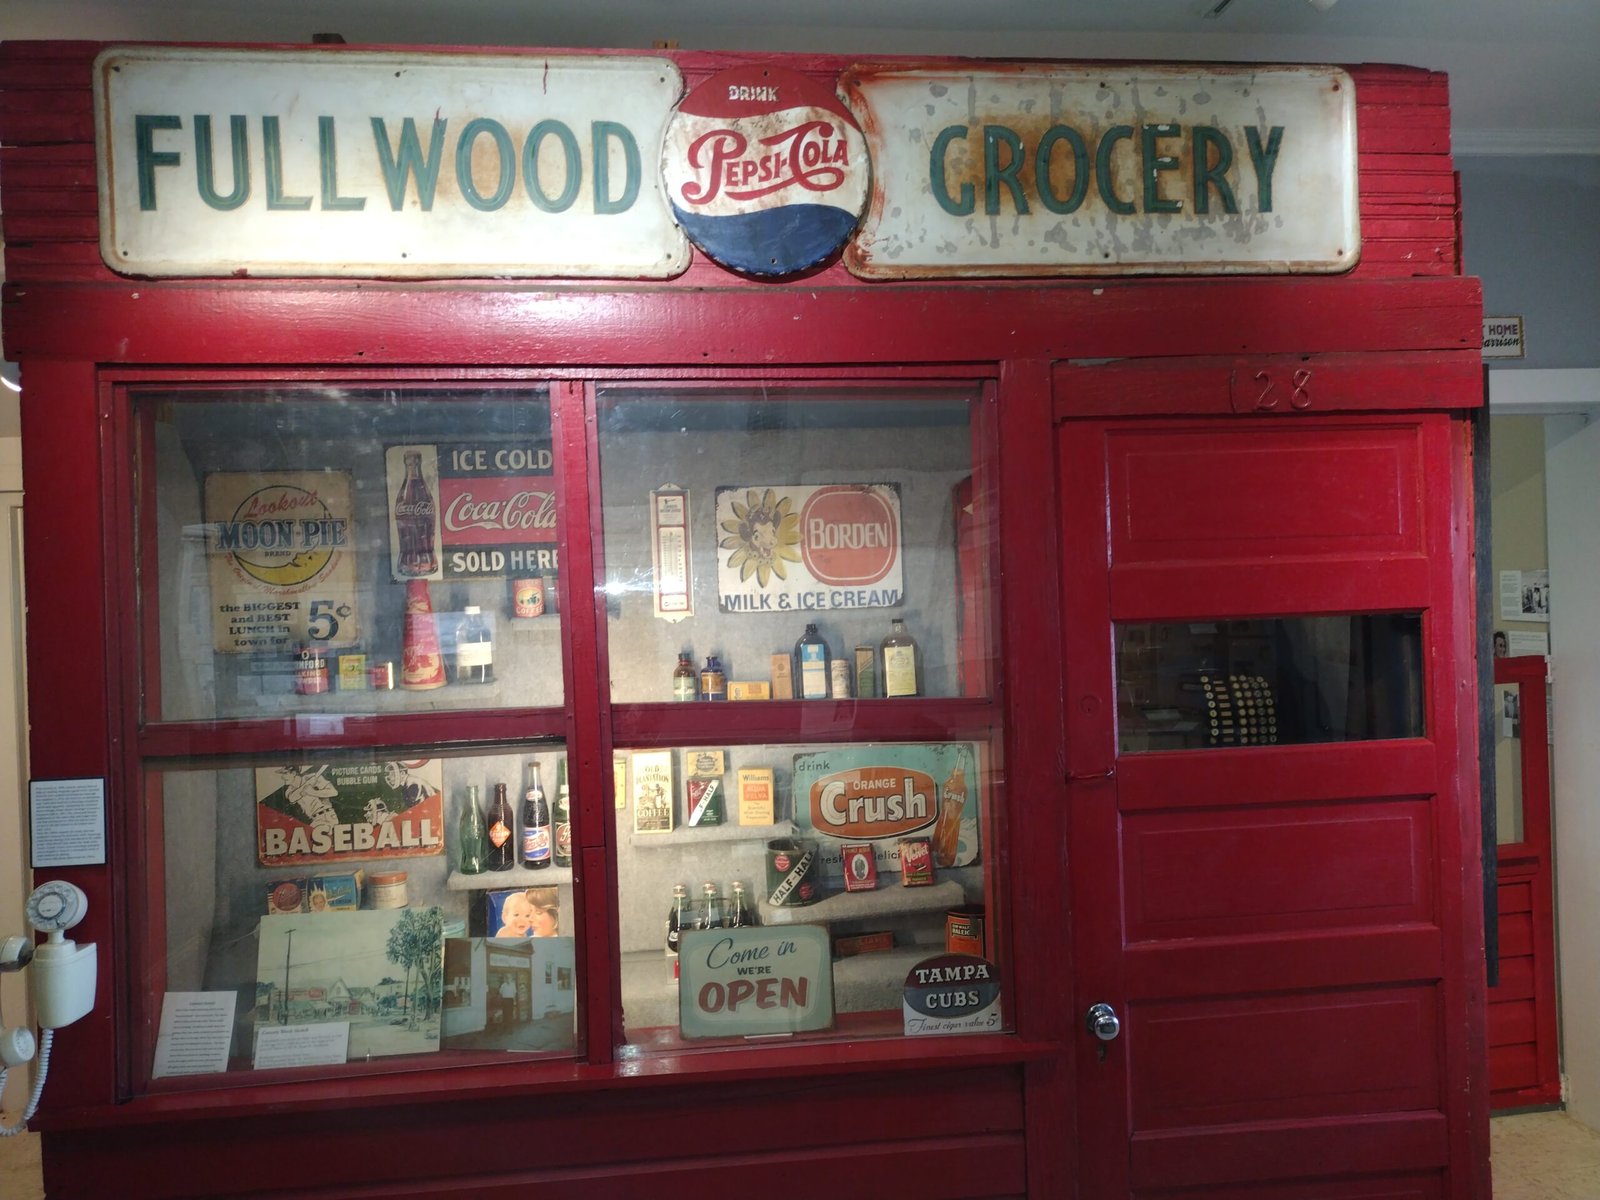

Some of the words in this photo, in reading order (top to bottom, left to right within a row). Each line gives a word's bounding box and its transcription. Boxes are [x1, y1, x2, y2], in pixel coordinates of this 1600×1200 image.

[728, 85, 779, 102] DRINK
[134, 114, 643, 214] FULLWOOD
[929, 124, 1285, 217] GROCERY
[1488, 324, 1518, 336] HOME
[1482, 335, 1520, 348] arrison
[452, 450, 487, 471] ICE
[495, 449, 553, 470] COLD
[243, 489, 318, 519] Lookout
[445, 491, 557, 532] Coca-Cola
[809, 518, 888, 549] BORDEN
[452, 551, 505, 572] SOLD
[220, 604, 241, 613] the
[243, 601, 301, 612] BIGGEST
[725, 594, 771, 611] MILK
[778, 593, 792, 609] &
[797, 592, 825, 609] ICE
[830, 589, 898, 606] CREAM
[231, 614, 254, 624] and
[257, 613, 290, 621] BEST
[229, 624, 275, 635] LUNCH
[278, 625, 290, 633] in
[234, 637, 267, 647] town
[270, 635, 288, 646] for
[331, 766, 358, 776] PICTURE
[360, 765, 382, 775] CARDS
[799, 760, 830, 772] drink
[336, 777, 361, 786] BUBBLE
[363, 776, 378, 785] GUM
[853, 778, 897, 791] ORANGE
[820, 777, 927, 826] Crush
[637, 808, 669, 817] COFFEE
[265, 819, 439, 855] BASEBALL
[820, 853, 843, 864] resh
[707, 937, 771, 969] Come
[777, 941, 797, 956] in
[737, 966, 772, 975] WE'RE
[915, 964, 990, 983] TAMPA
[698, 976, 808, 1013] OPEN
[926, 990, 980, 1009] CUBS
[908, 1018, 941, 1034] Finest
